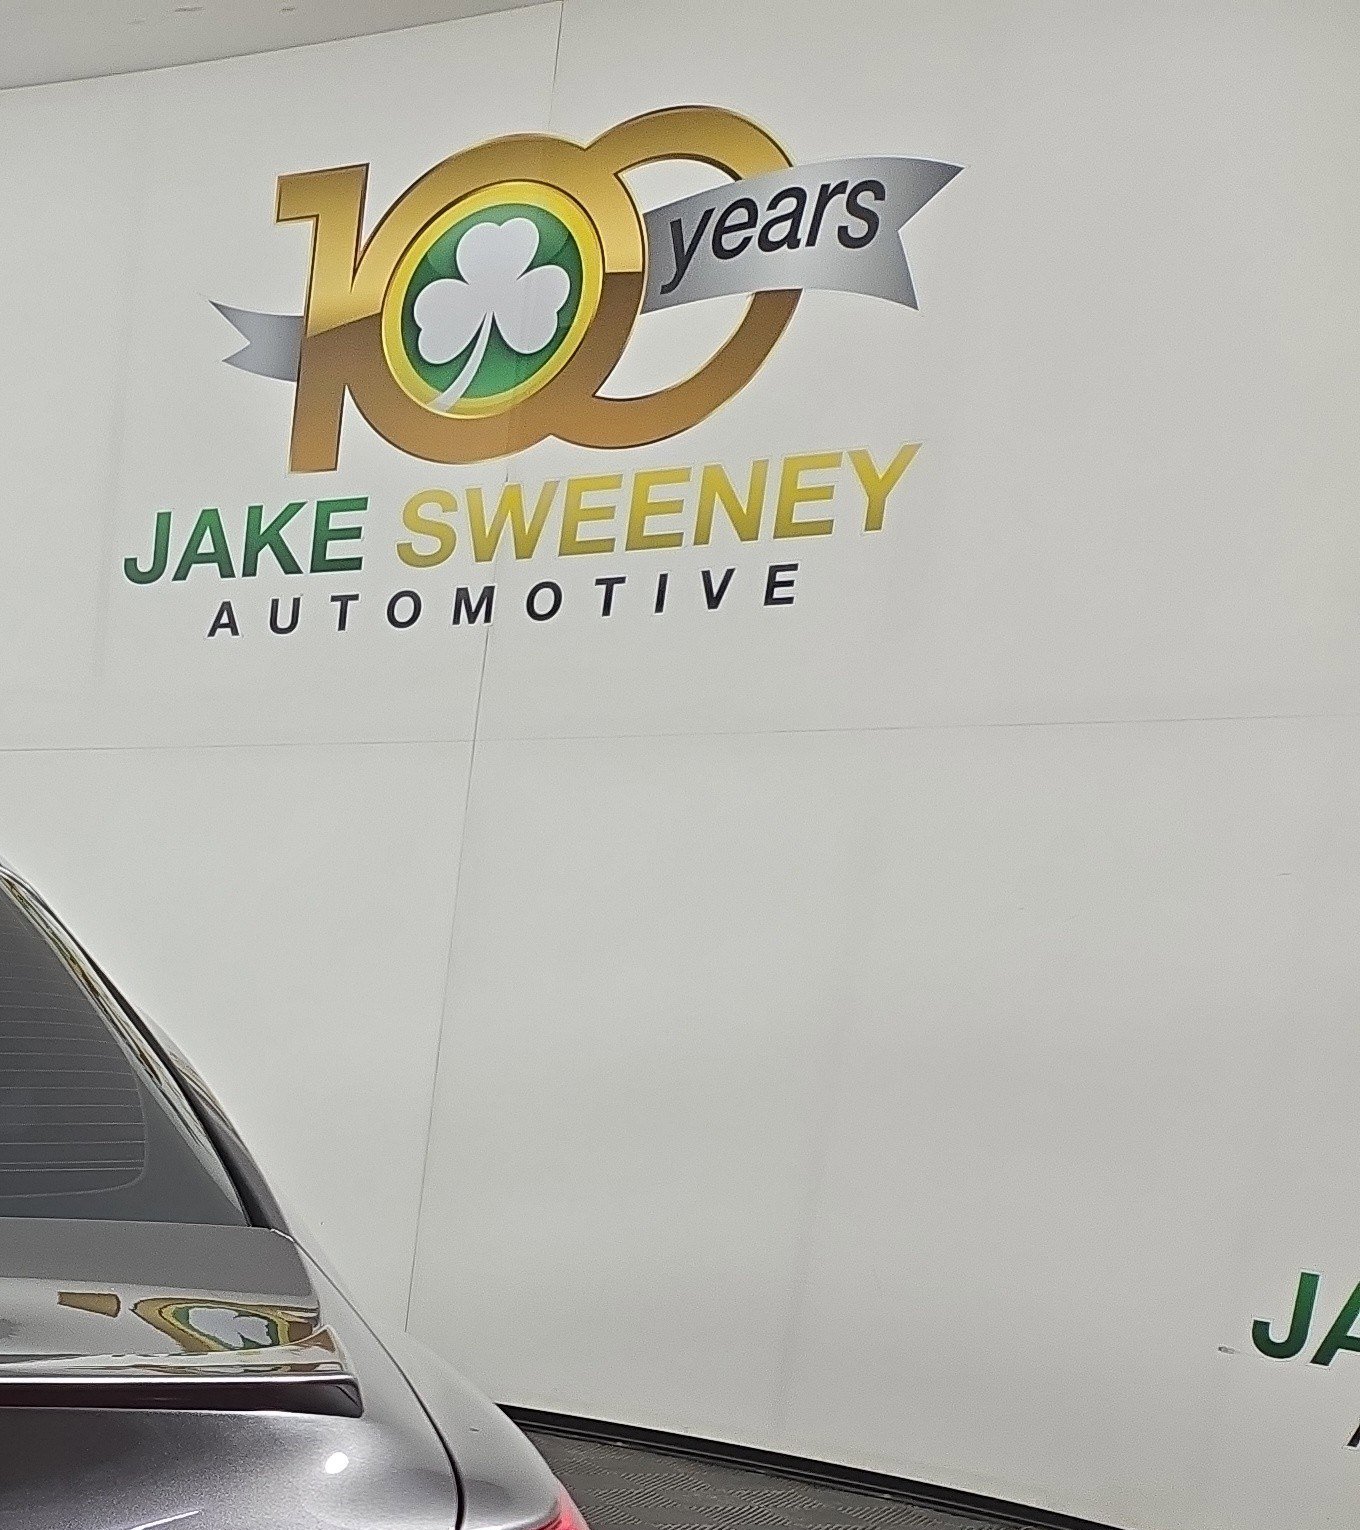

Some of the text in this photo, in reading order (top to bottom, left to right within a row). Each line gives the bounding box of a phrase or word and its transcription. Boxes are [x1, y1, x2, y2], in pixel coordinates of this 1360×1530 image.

[658, 178, 886, 296] years
[123, 443, 921, 586] JAKE SWEENEY
[206, 563, 800, 638] AUTOMOTIVE
